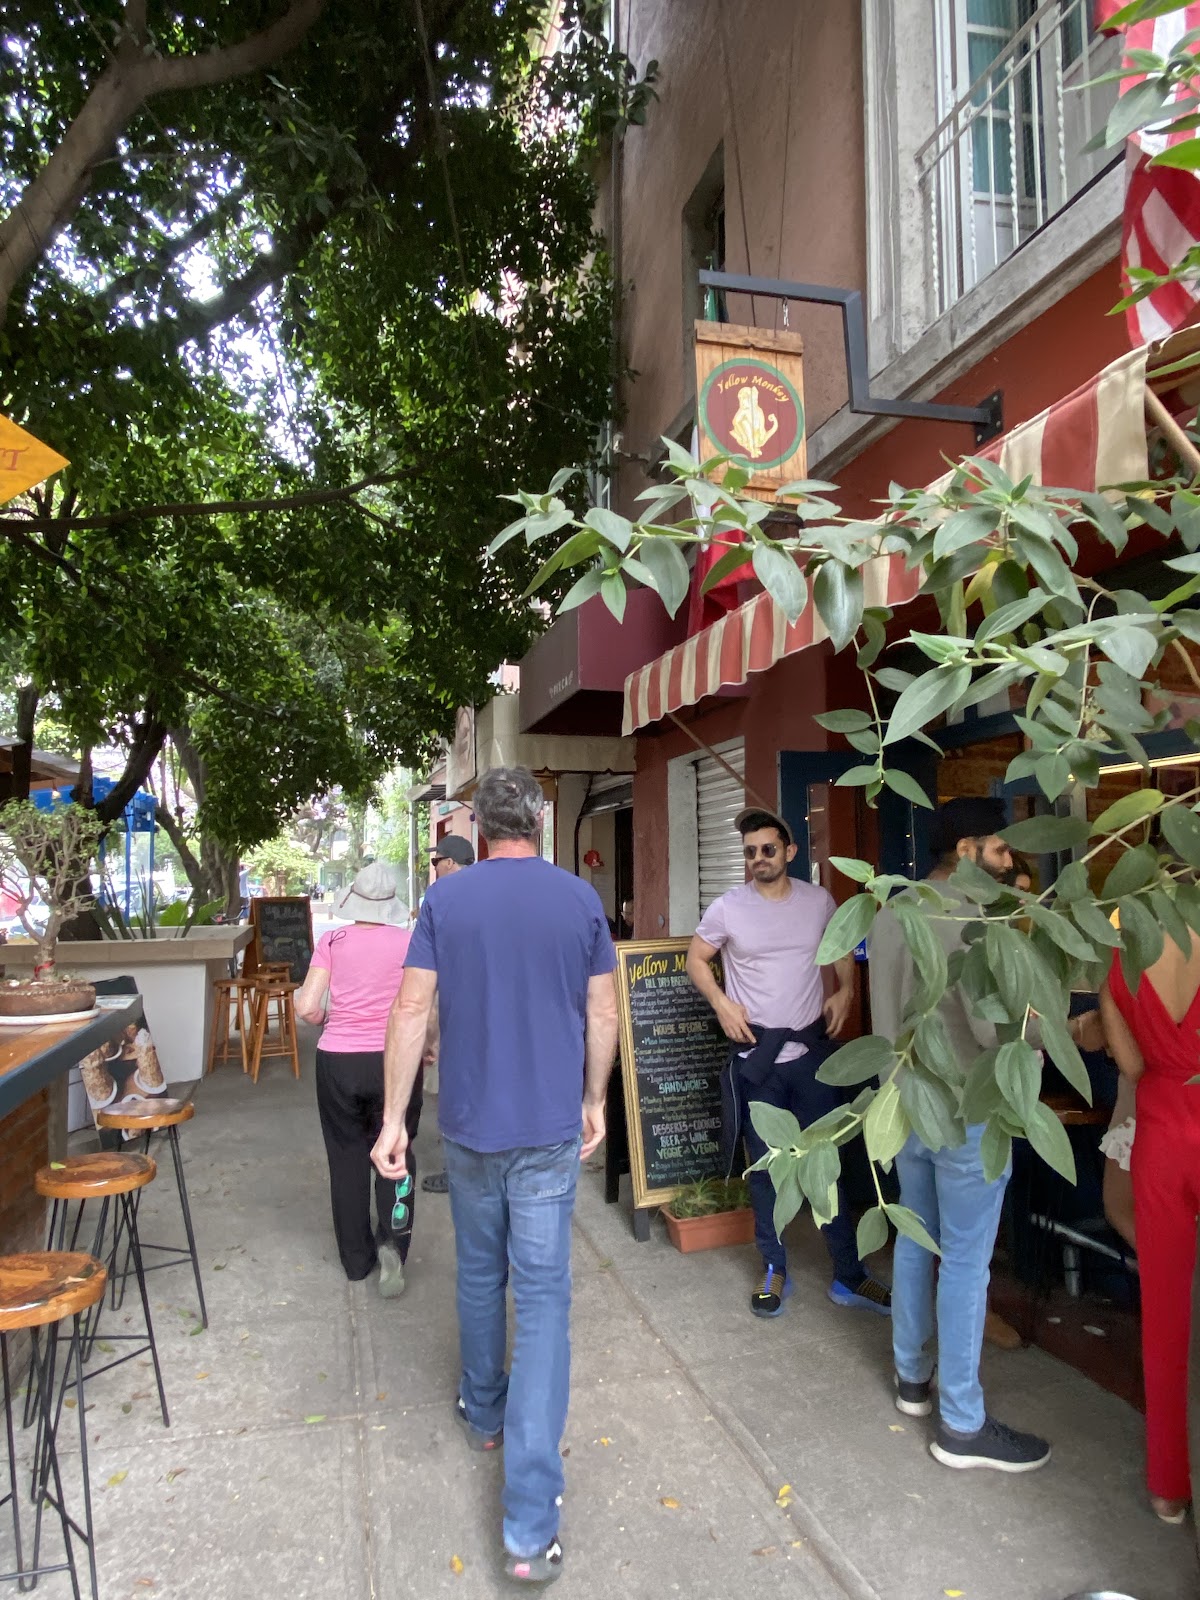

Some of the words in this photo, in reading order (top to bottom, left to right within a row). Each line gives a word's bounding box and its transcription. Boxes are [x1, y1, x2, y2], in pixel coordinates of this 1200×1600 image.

[717, 374, 749, 394] Yellow
[752, 376, 790, 402] Monkey
[654, 1025, 677, 1036] HOUSE
[679, 1022, 709, 1034] SPECIALS
[659, 1079, 709, 1095] SANDWICHES
[652, 1121, 689, 1137] DESSERTS
[694, 1118, 722, 1132] COOKIES
[661, 1134, 681, 1148] BEER
[690, 1131, 709, 1143] WINE
[657, 1146, 683, 1160] VEGGIE
[692, 1141, 719, 1155] VEGAN
